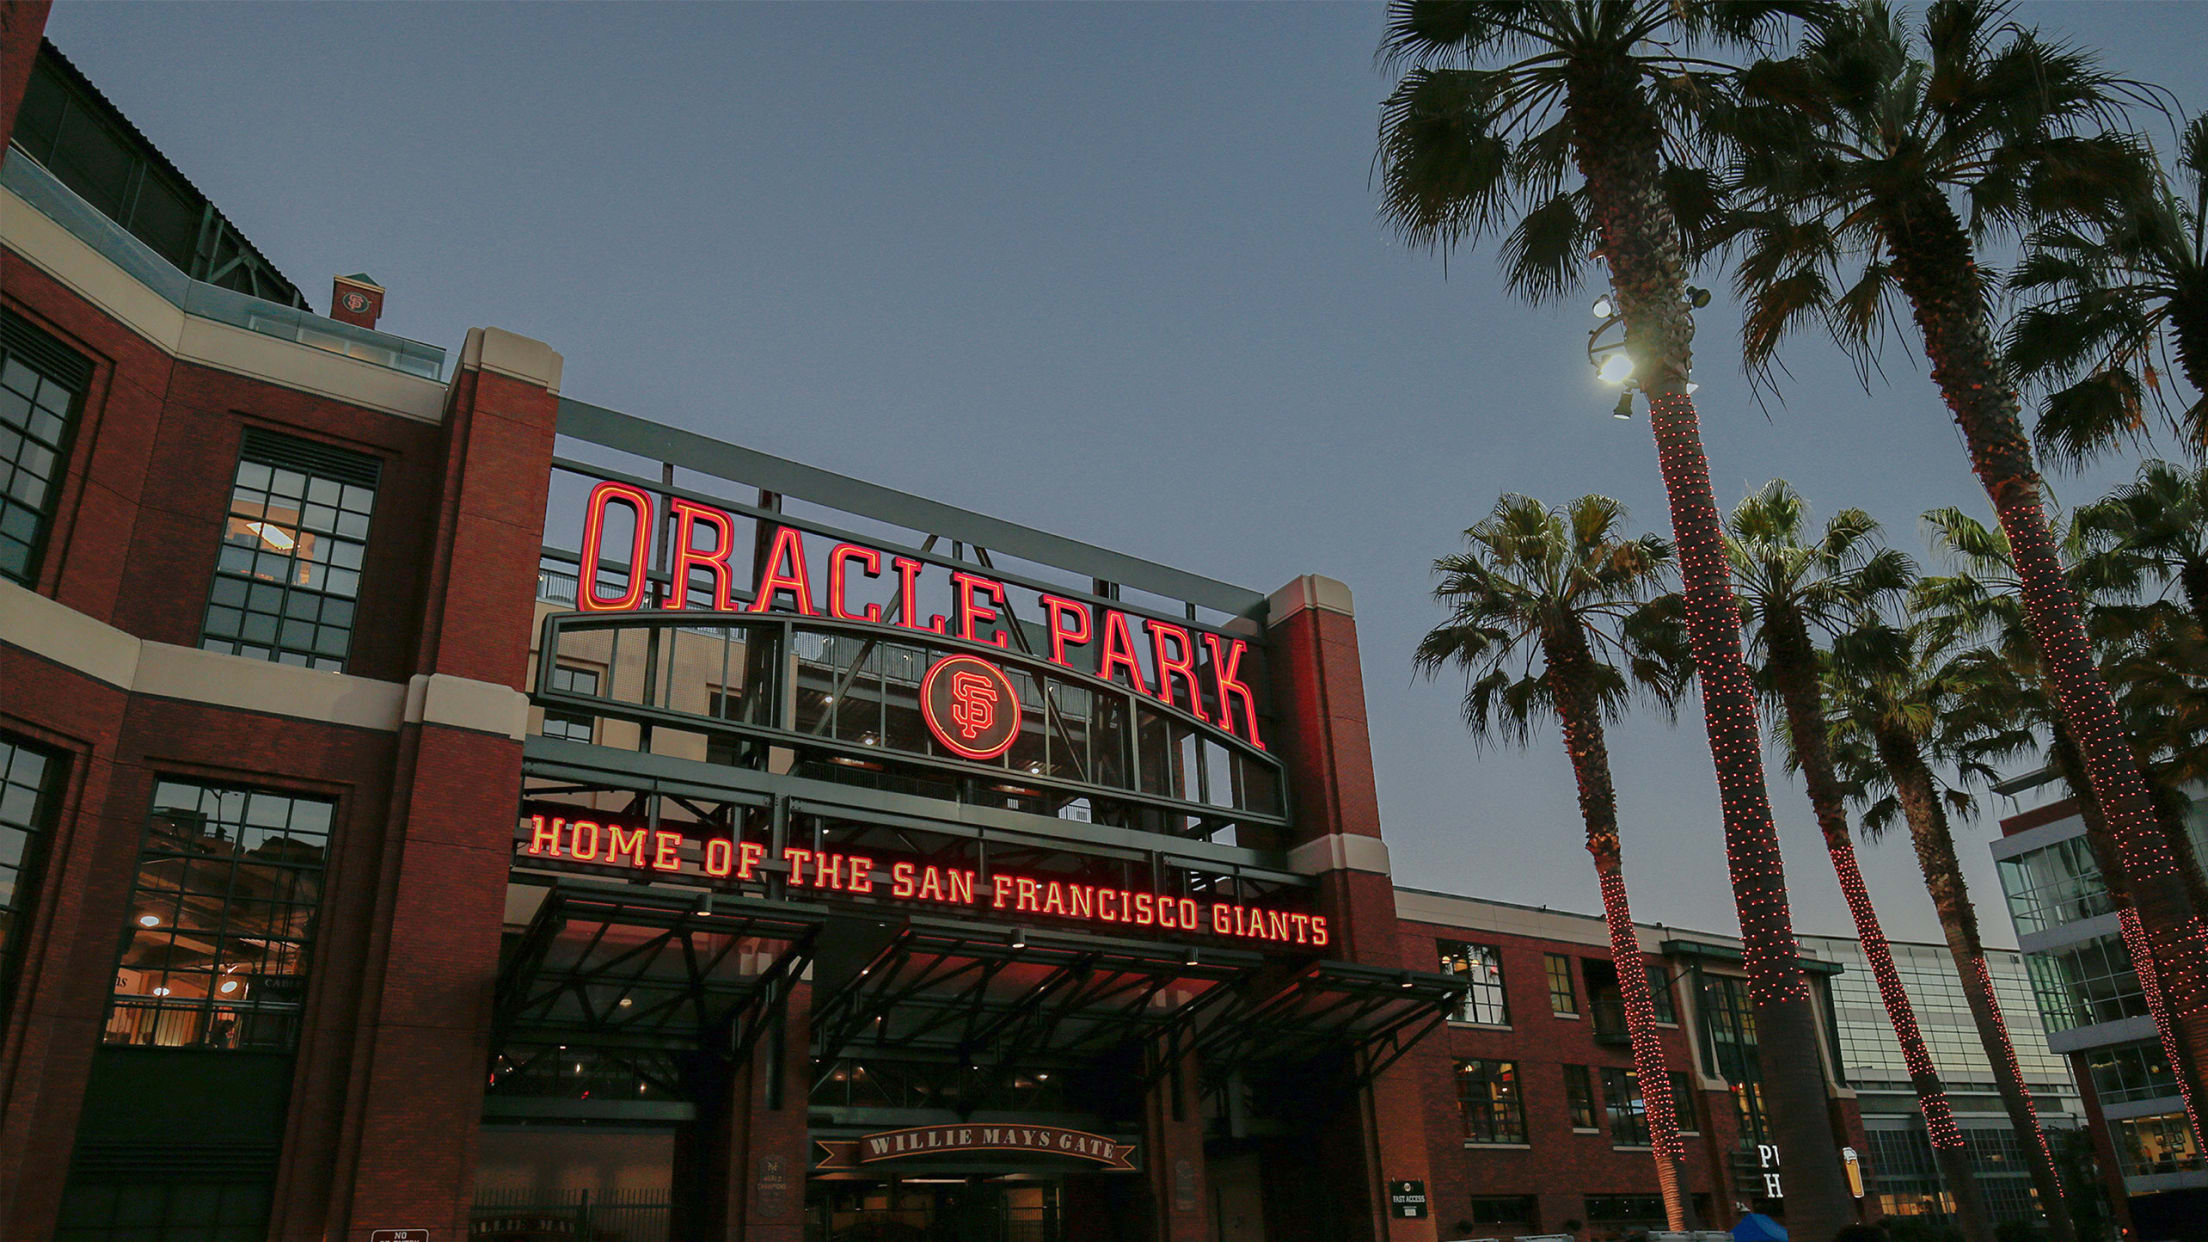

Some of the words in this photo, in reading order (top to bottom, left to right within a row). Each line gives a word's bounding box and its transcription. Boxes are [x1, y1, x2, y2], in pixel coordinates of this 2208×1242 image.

[576, 481, 1008, 649] ORACLE
[1038, 594, 1267, 751] PARK
[528, 814, 682, 871] HOME
[705, 837, 763, 879] OF
[784, 847, 872, 894] THE
[892, 862, 975, 904] SAN
[992, 873, 1198, 930] FRANCISCO
[1212, 902, 1329, 945] GIANTS
[869, 1129, 973, 1155] WILLIE
[982, 1128, 1051, 1147] MAYS
[1059, 1133, 1115, 1159] GATE
[1757, 1144, 1780, 1168] P
[1392, 1195, 1405, 1203] FAST
[1405, 1195, 1426, 1203] ACCESS
[394, 1232, 408, 1240] NO
